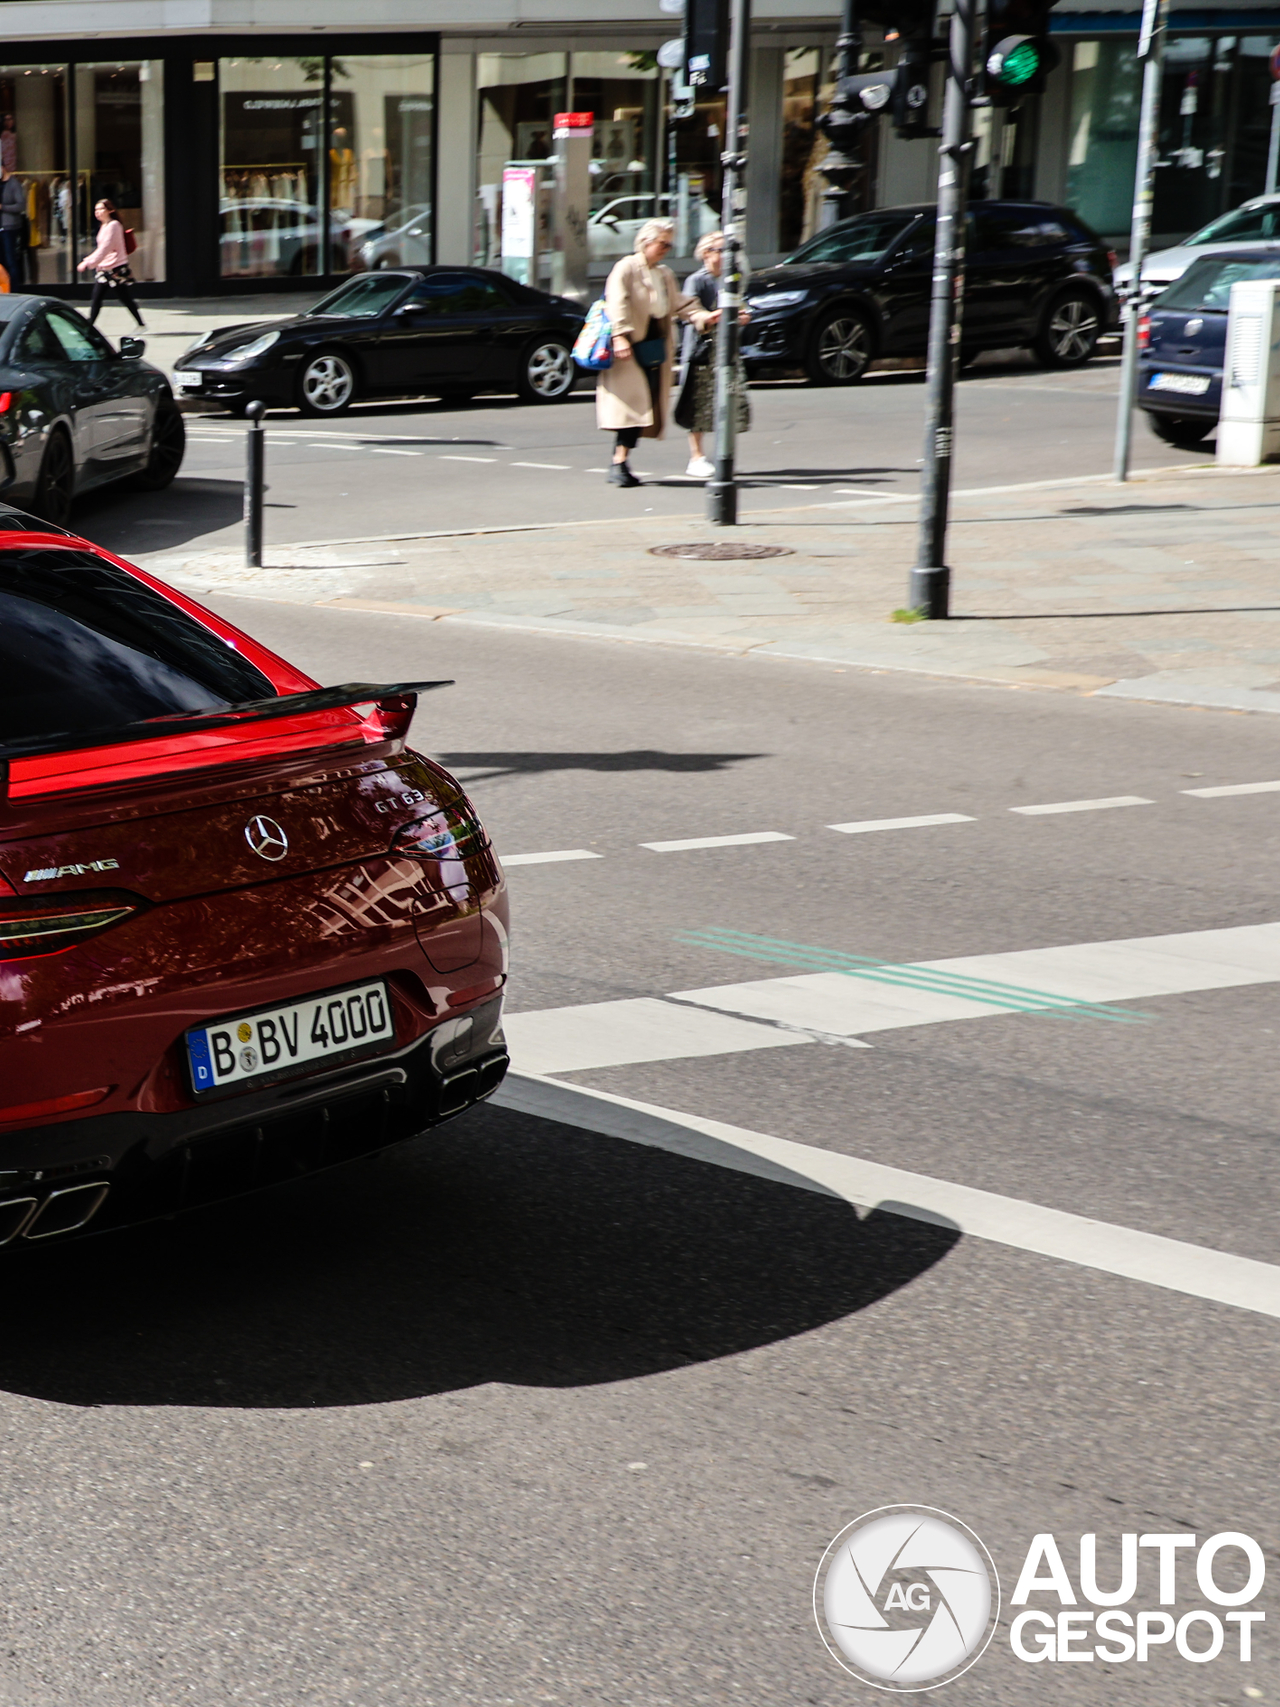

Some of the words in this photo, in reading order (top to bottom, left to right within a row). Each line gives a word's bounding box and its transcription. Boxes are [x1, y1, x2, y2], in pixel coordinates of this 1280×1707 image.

[374, 797, 399, 814] GT
[401, 789, 425, 805] 63
[55, 858, 120, 879] AMG
[211, 1031, 237, 1078] B
[256, 1011, 299, 1066] BV
[310, 989, 387, 1049] 4000
[197, 1065, 208, 1080] D
